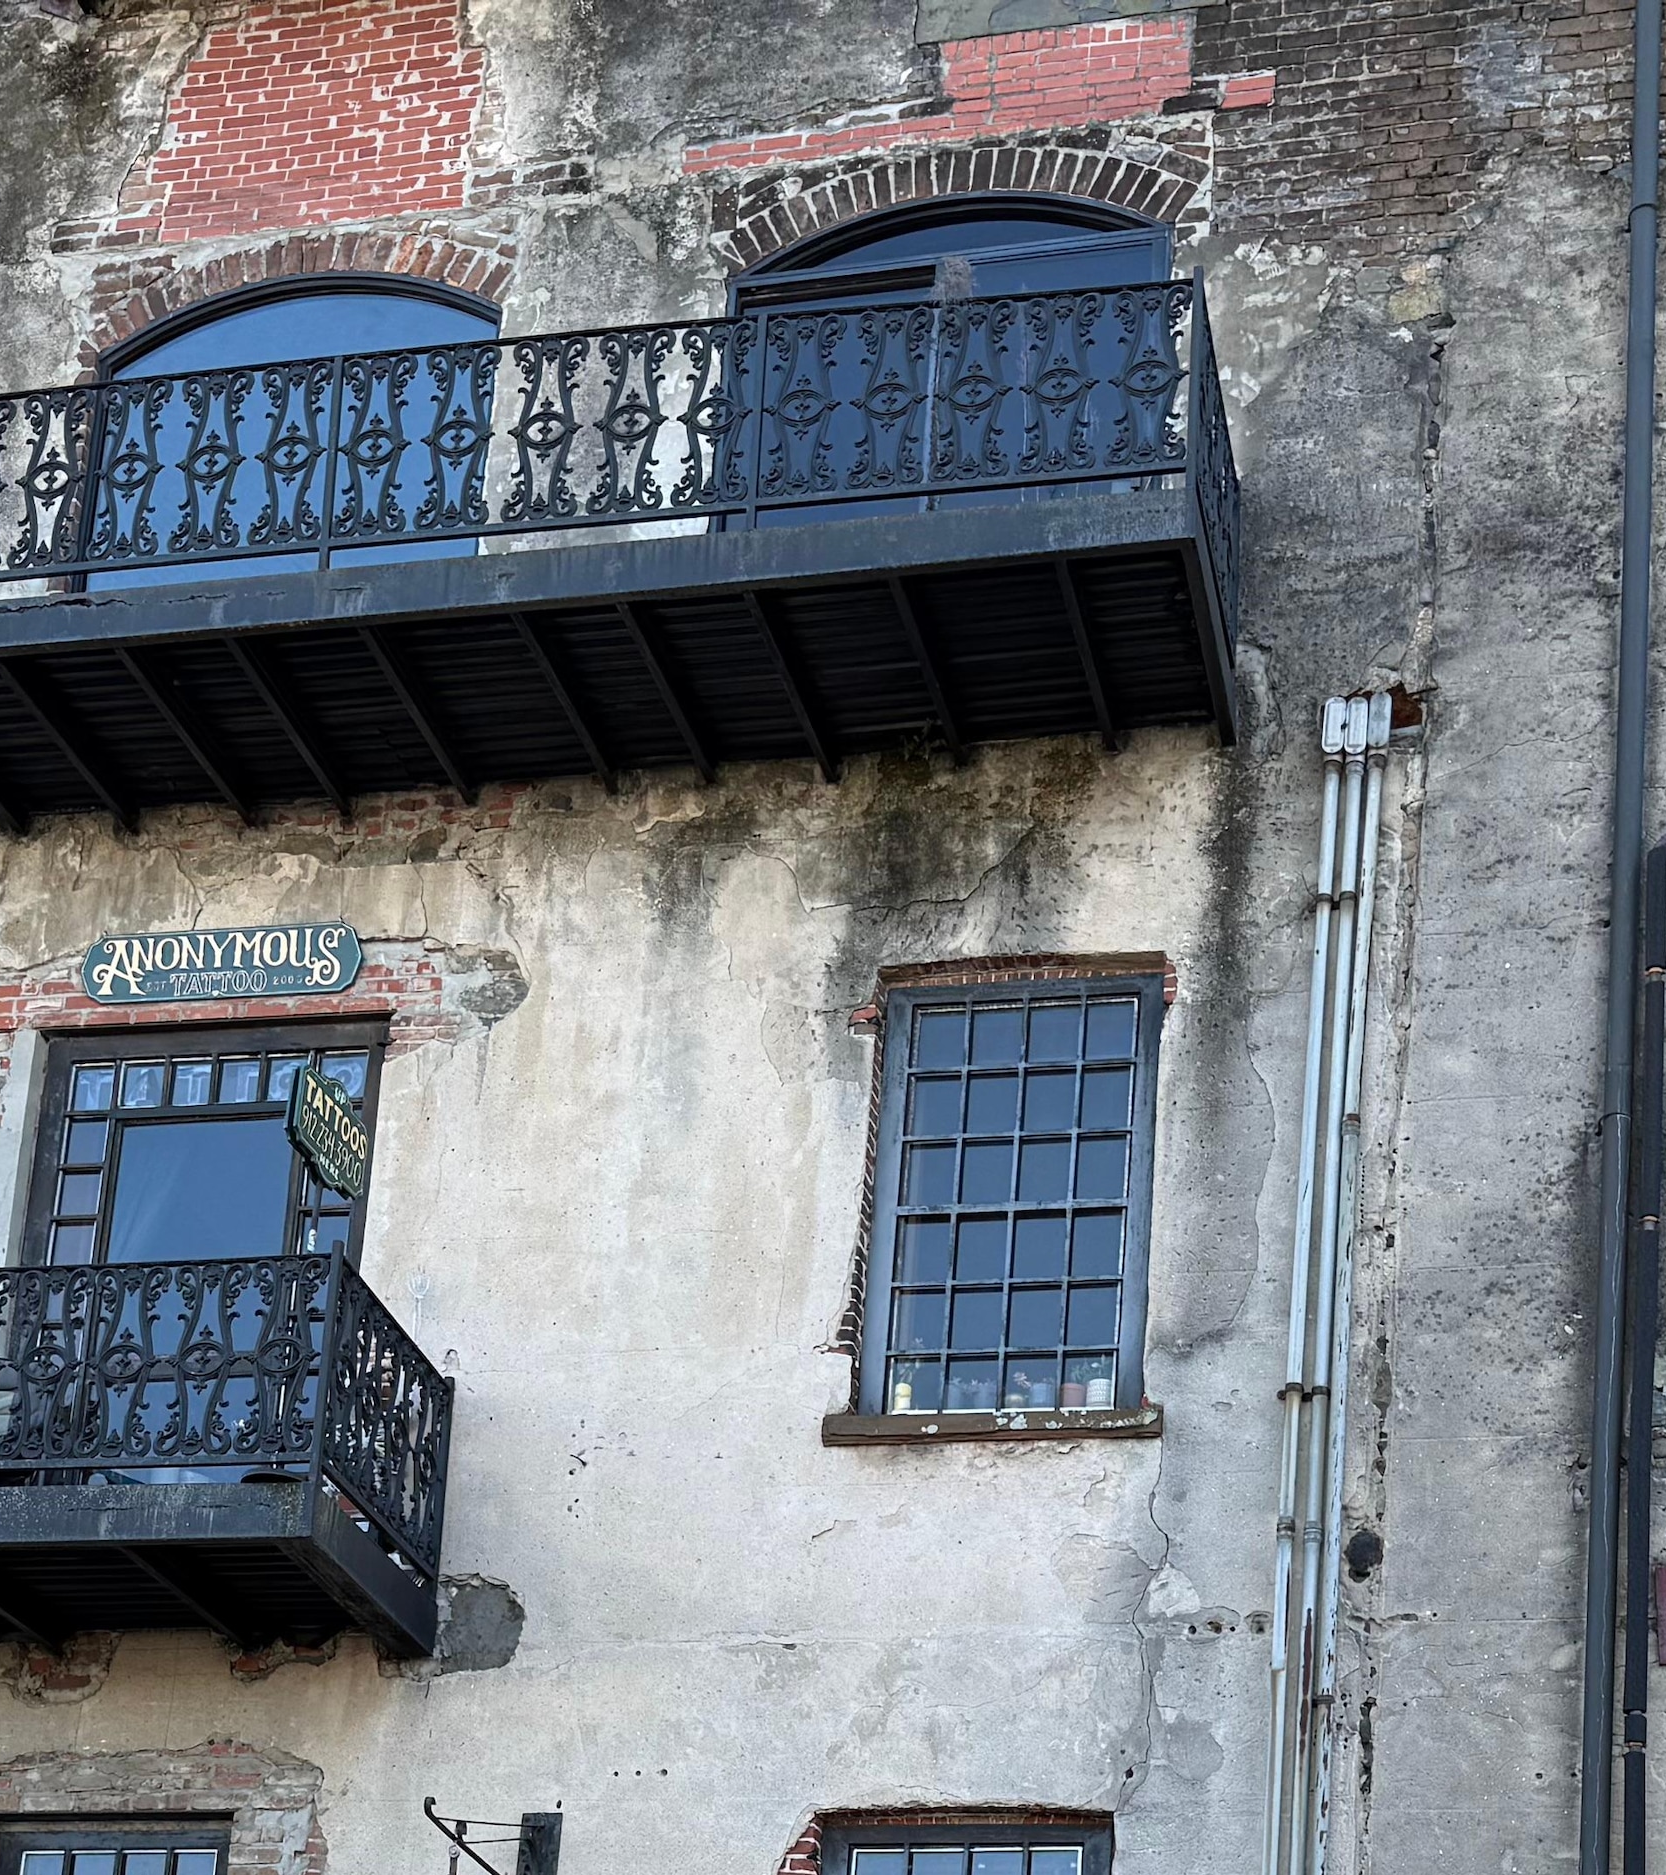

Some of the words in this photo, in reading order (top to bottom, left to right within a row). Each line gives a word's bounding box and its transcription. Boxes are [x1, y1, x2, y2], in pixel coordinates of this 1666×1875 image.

[92, 927, 347, 996] ANONYMOUS
[169, 969, 268, 997] TATTOO
[306, 1074, 368, 1160] TATTOOS
[334, 1087, 348, 1105] UP
